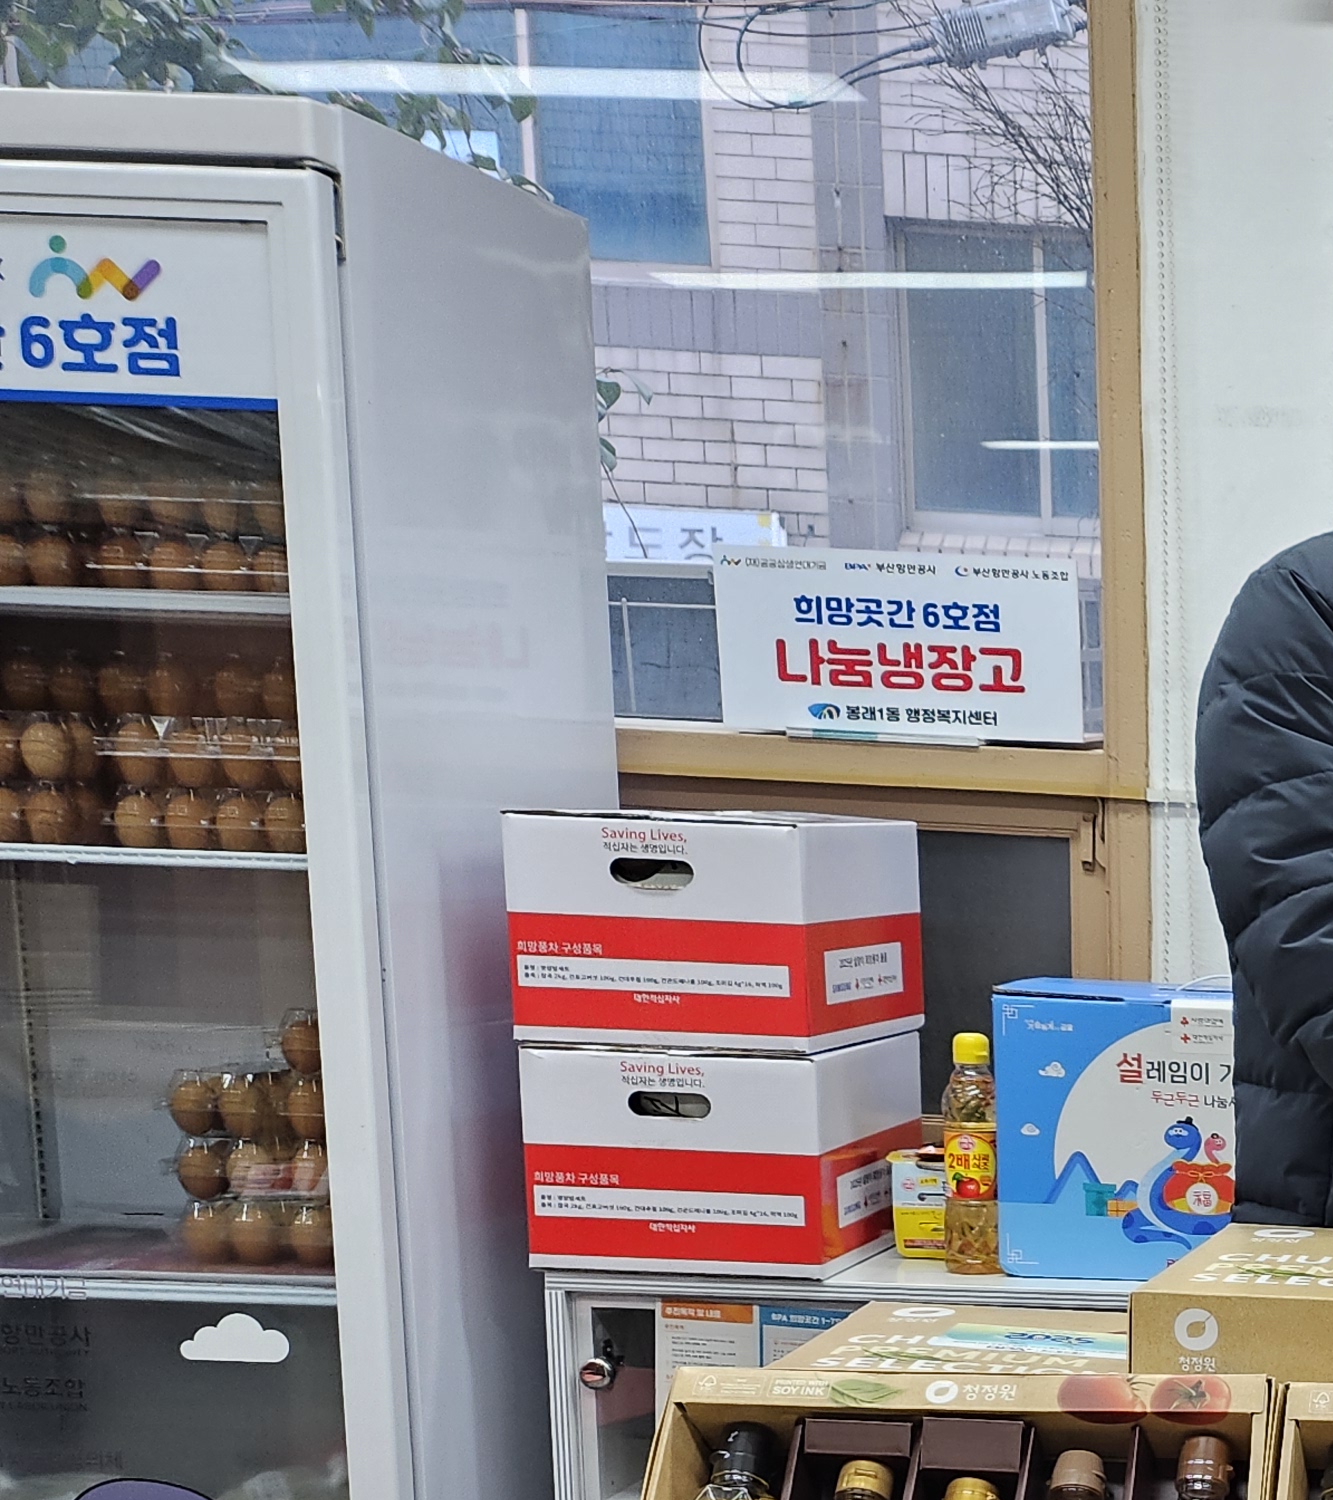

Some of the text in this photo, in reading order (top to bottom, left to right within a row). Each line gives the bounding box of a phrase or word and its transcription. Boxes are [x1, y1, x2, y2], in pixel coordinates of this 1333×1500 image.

[20, 313, 181, 378] 6호점
[876, 563, 936, 575] 부산항만공사
[973, 567, 1029, 580] 부산항만공사
[793, 594, 1001, 633] 희망곳간 6호점
[775, 638, 1026, 693] 나눔냉장고
[846, 705, 998, 726] 봉래1동 행정복지센터
[601, 826, 688, 844] Saving Lives,
[1115, 1051, 1210, 1086] 설레임이
[1151, 1090, 1200, 1107] 두근두근
[1192, 1188, 1212, 1208] 福
